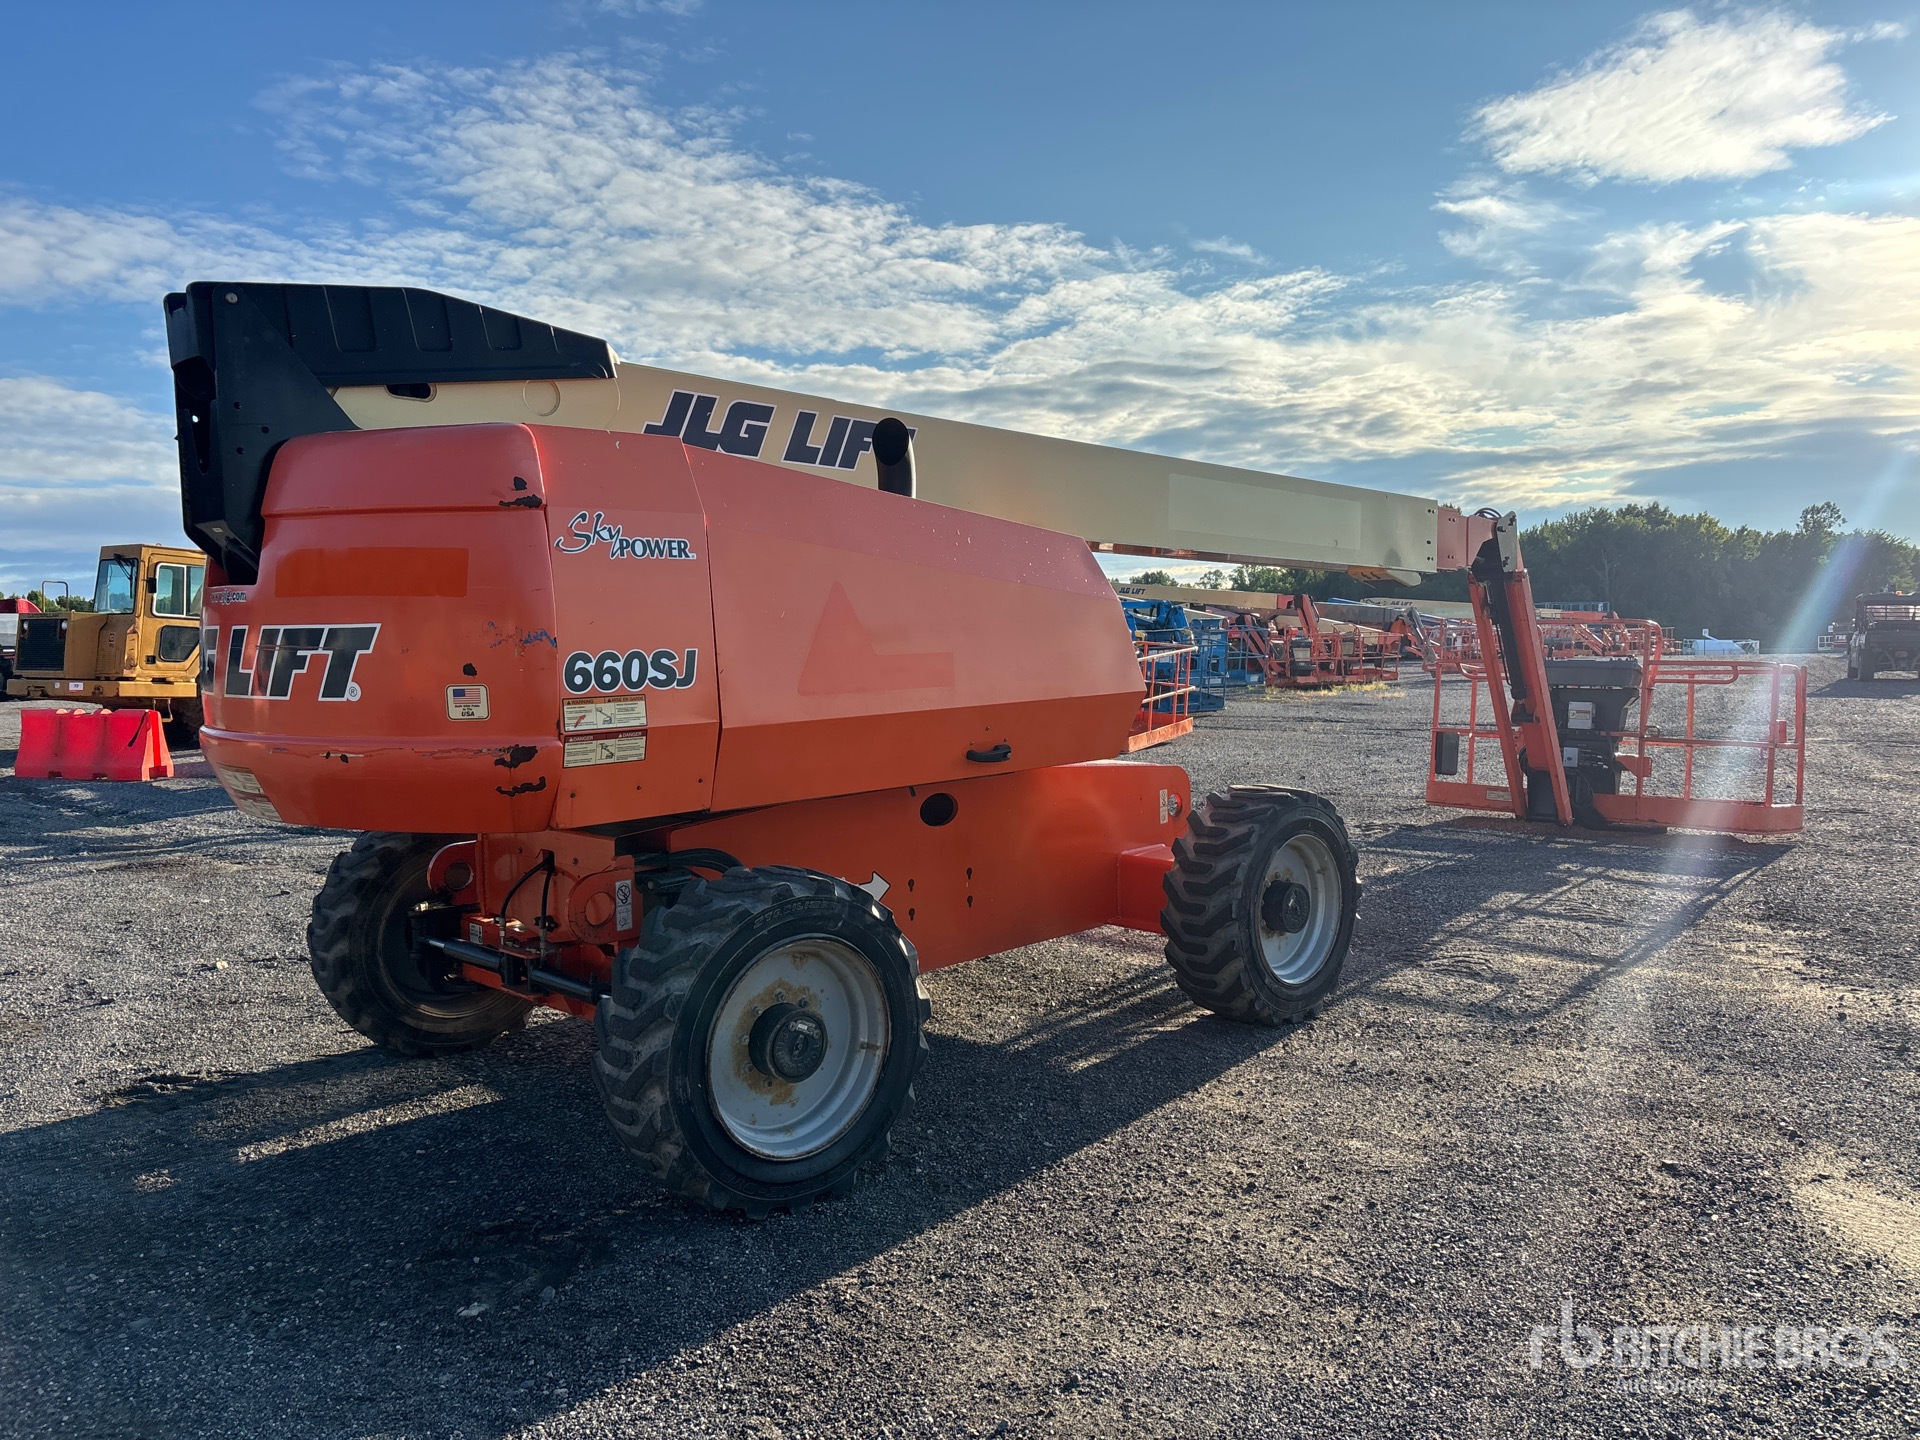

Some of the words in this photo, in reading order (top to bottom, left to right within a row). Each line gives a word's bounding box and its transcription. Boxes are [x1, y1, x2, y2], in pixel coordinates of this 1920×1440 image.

[642, 389, 777, 459] JLG
[781, 409, 918, 471] LIF
[1119, 586, 1131, 594] JLG
[1131, 587, 1146, 595] LIFT
[224, 623, 381, 701] LIFT
[562, 648, 699, 695] 660SJ
